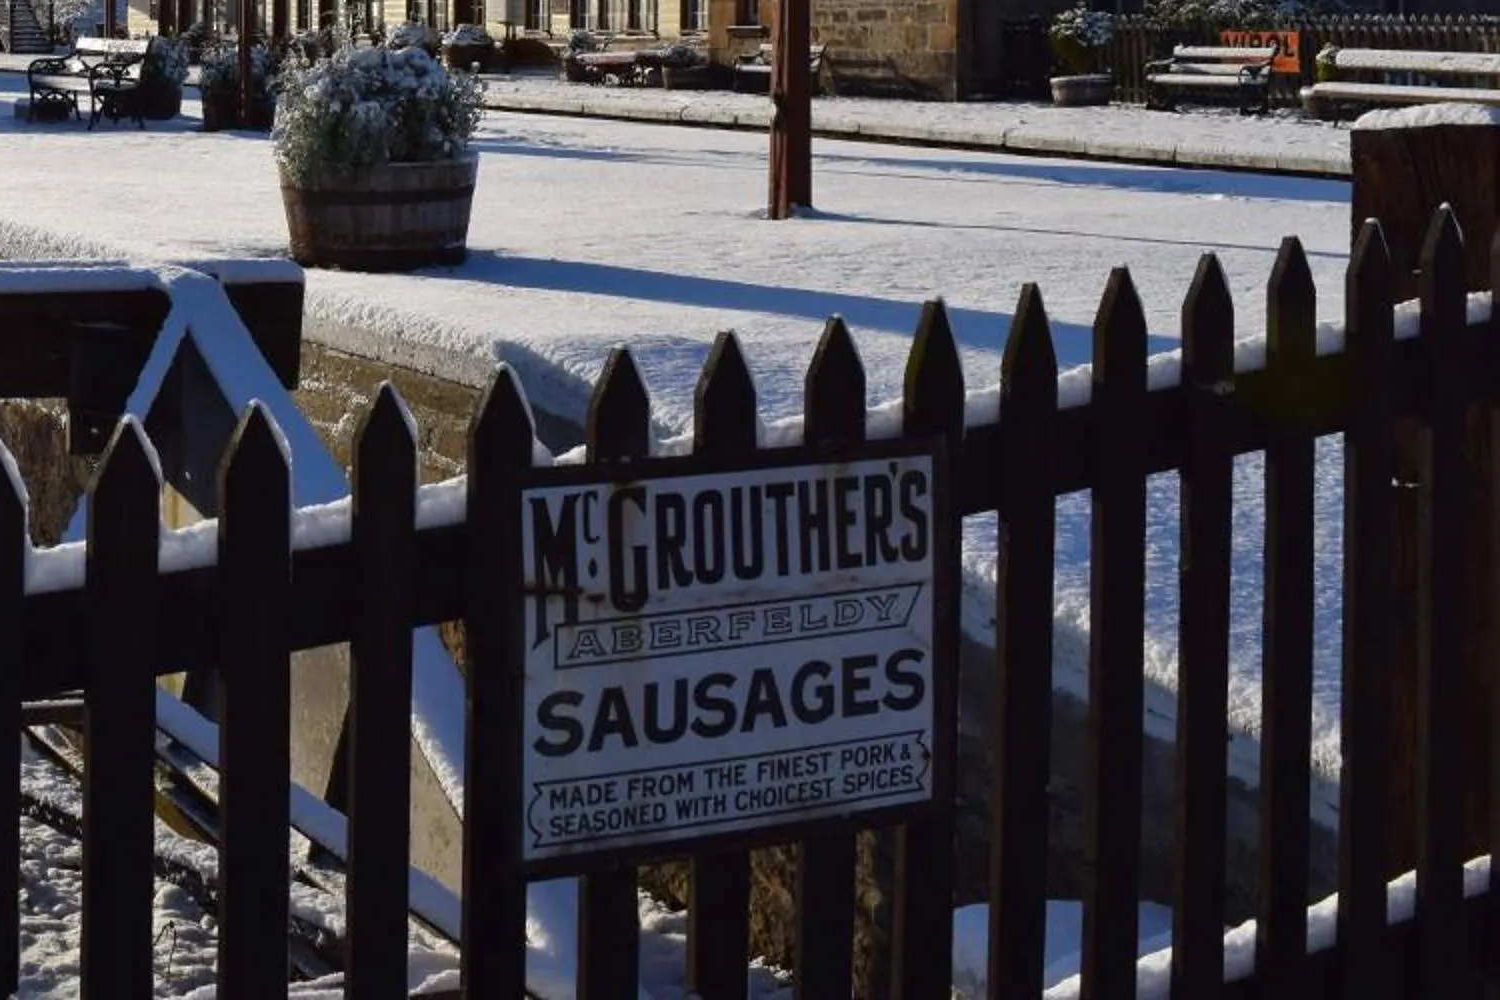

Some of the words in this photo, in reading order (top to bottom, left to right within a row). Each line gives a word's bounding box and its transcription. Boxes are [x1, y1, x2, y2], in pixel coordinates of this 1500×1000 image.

[566, 593, 901, 660] ABERFELDY
[532, 647, 926, 758] SAUSAGES
[549, 781, 617, 810] MADE
[627, 770, 695, 801] FROM
[703, 763, 747, 790] THE
[757, 752, 833, 782] FINEST
[841, 743, 896, 770] PORK
[900, 743, 911, 761] &
[549, 802, 667, 837] SEASONED
[675, 793, 727, 820] WITH
[735, 777, 835, 811] CHOICEST
[842, 764, 914, 795] SPICES
